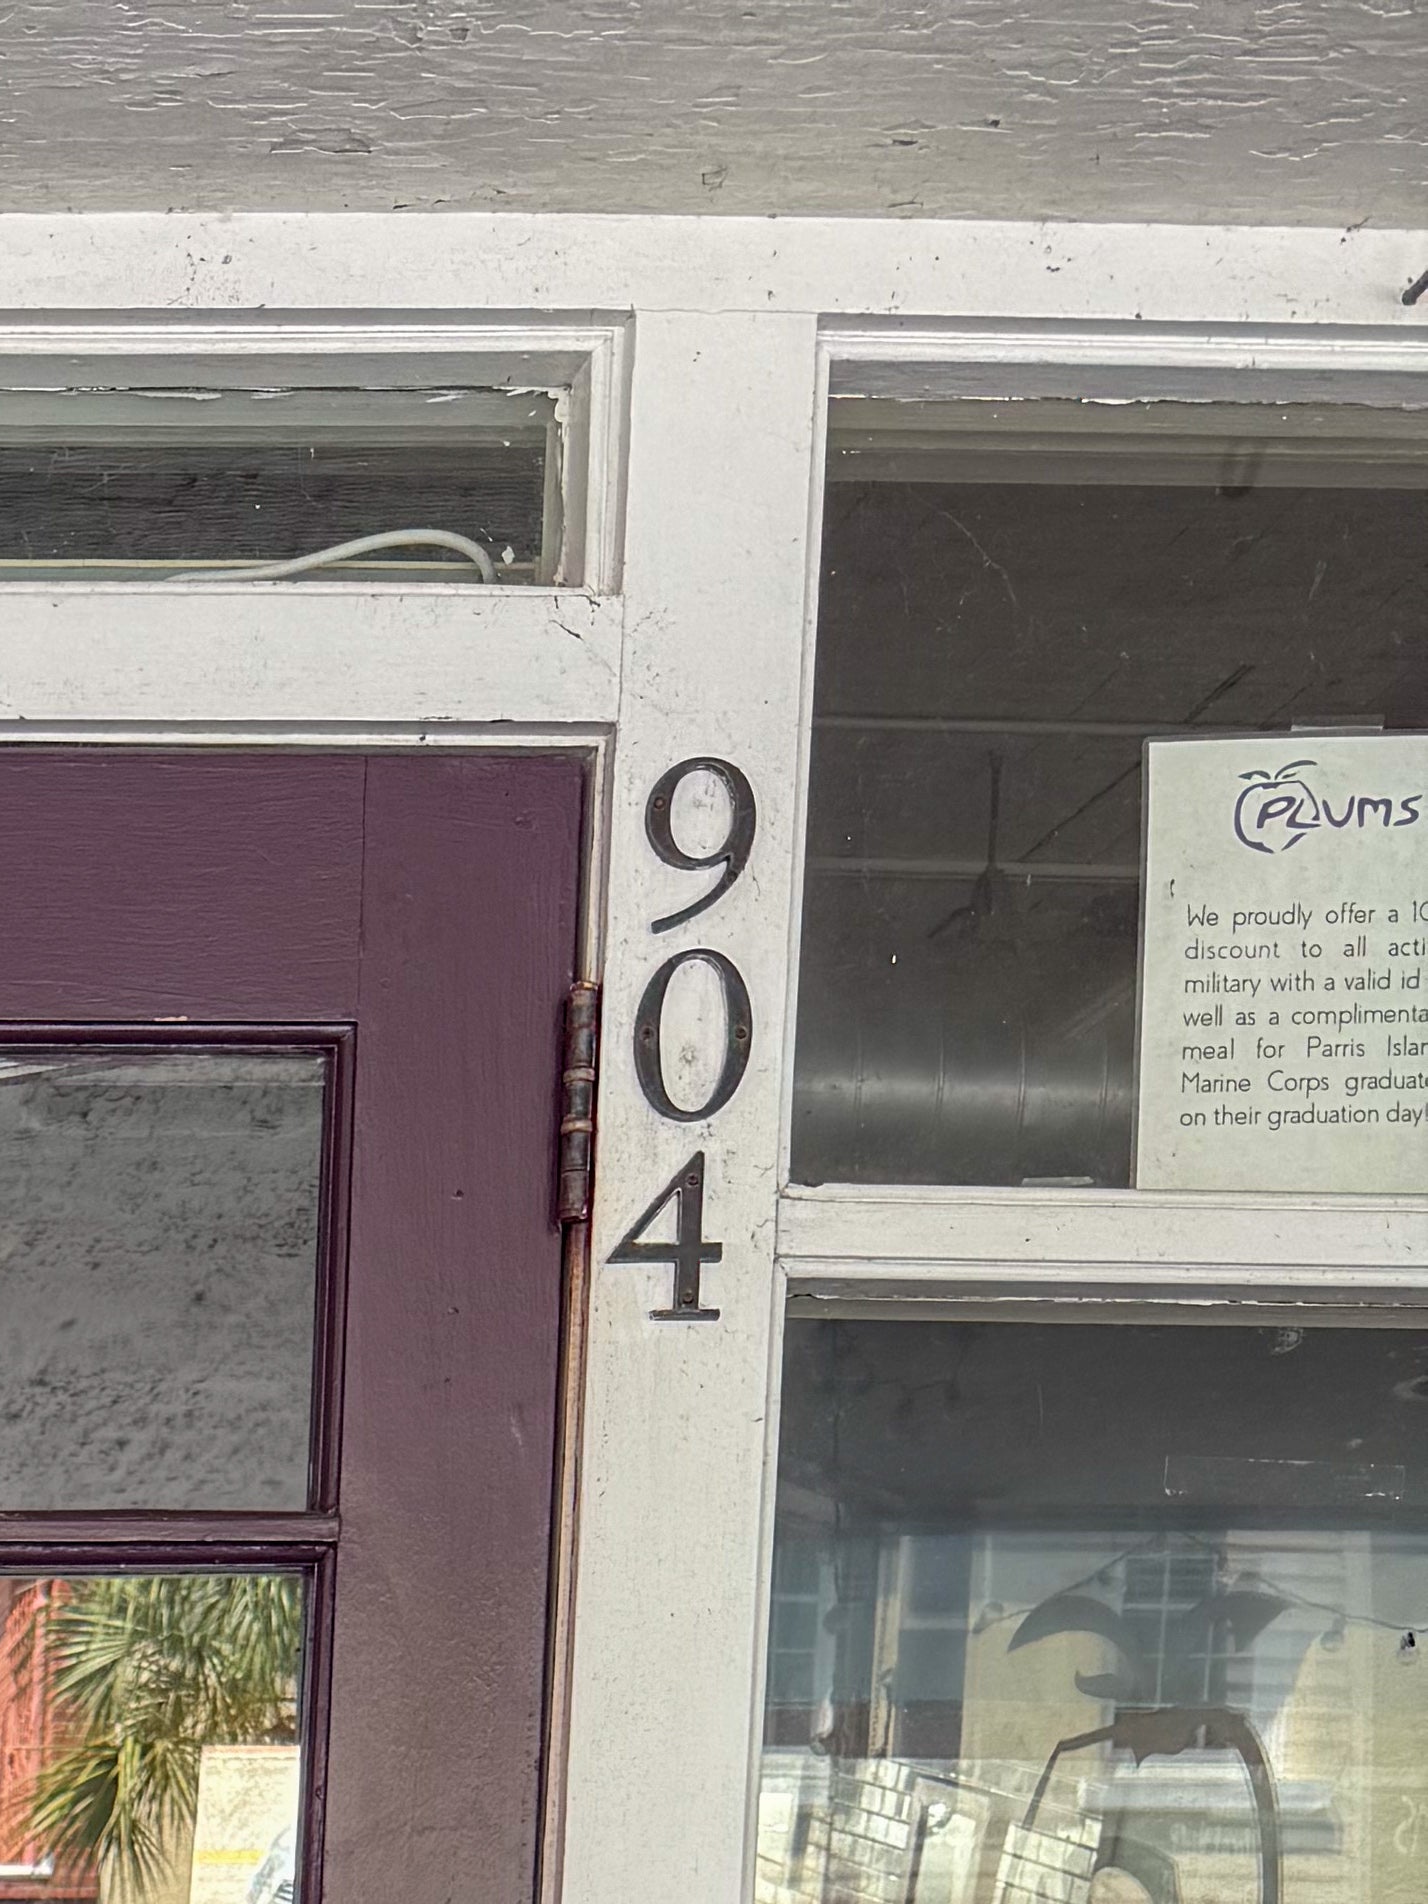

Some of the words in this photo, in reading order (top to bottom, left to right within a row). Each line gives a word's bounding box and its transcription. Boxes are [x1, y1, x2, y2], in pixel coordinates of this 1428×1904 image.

[1187, 904, 1219, 927] We
[1232, 902, 1313, 935] proudly
[1325, 902, 1376, 925] offer
[1387, 909, 1399, 923] a
[1184, 937, 1280, 959] discount
[1301, 940, 1322, 958] to
[1343, 935, 1366, 957] all
[1184, 971, 1261, 998] military
[1270, 969, 1314, 992] with
[1324, 977, 1335, 991] a
[1344, 968, 1391, 991] valid
[1401, 967, 1421, 990] id
[1183, 1004, 1223, 1027] well
[1235, 1012, 1256, 1026] as
[1268, 1011, 1280, 1026] a
[605, 756, 757, 1321] 904
[1182, 1037, 1235, 1060] meal
[1256, 1037, 1286, 1059] for
[1306, 1035, 1366, 1058] Parris
[1181, 1071, 1251, 1094] Marine
[1267, 1069, 1329, 1099] Corps
[1179, 1112, 1206, 1126] on
[1214, 1104, 1261, 1126] their
[1267, 1102, 1379, 1131] graduation
